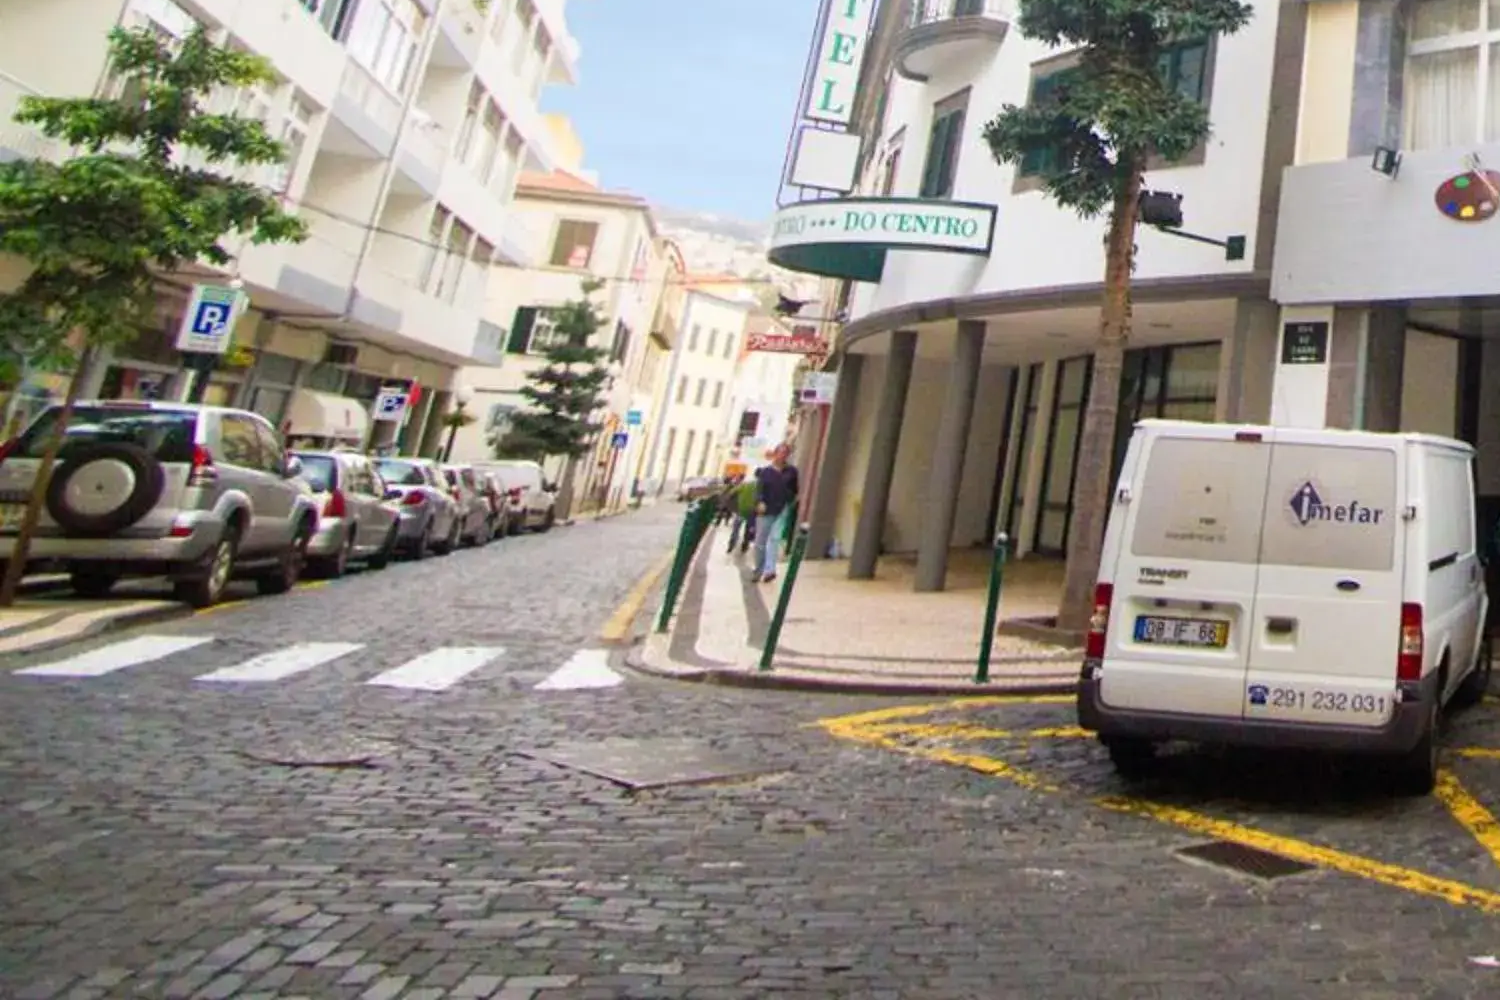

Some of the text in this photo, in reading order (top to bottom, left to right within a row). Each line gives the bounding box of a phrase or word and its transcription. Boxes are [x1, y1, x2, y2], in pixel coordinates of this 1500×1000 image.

[843, 210, 978, 238] DO CENTRO
[1300, 485, 1384, 524] imefar
[1139, 567, 1189, 580] TRANSIT
[1271, 687, 1386, 714] 291 232 031
